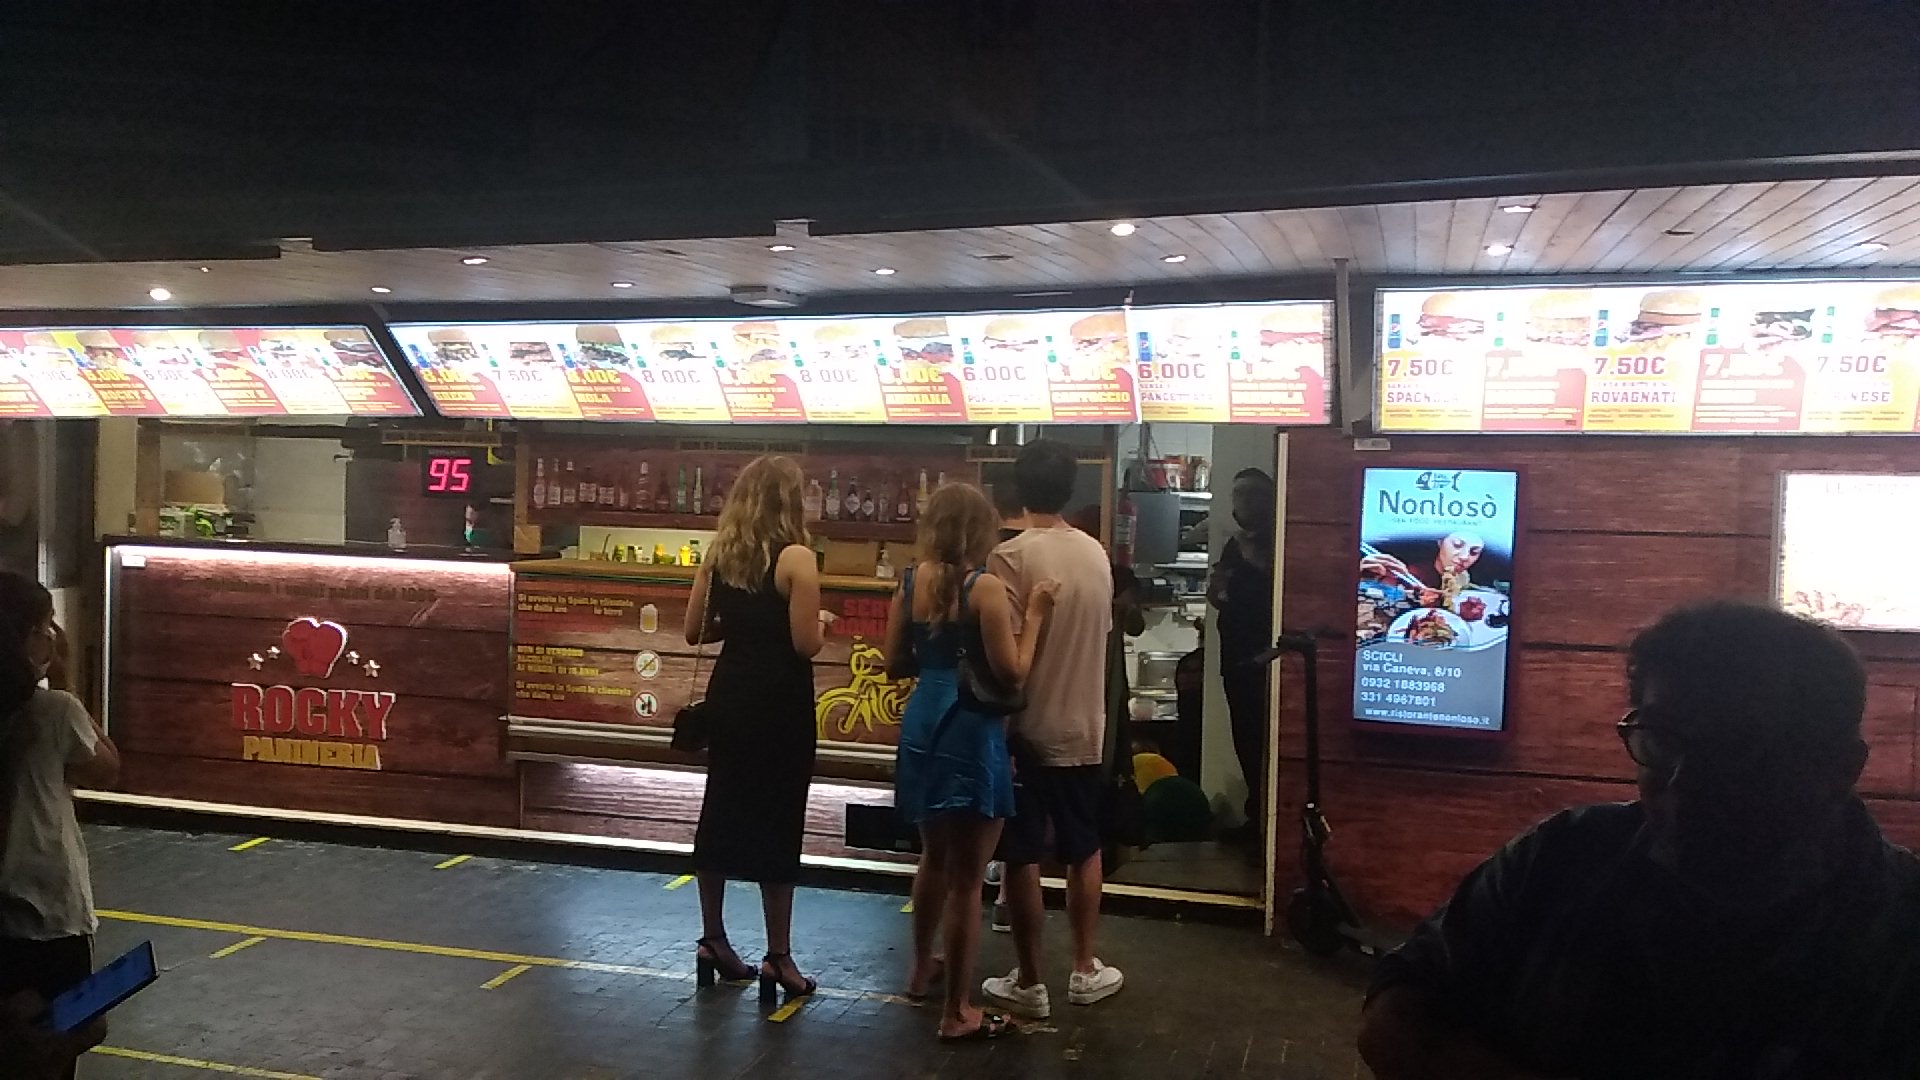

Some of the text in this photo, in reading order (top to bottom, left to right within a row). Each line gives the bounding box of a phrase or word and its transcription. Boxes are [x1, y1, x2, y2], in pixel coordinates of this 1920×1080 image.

[1387, 391, 1459, 403] SPAGNOA
[1591, 391, 1677, 403] ROVAGNATI
[427, 458, 472, 491] 95
[1379, 490, 1497, 519] Nonlosò
[1362, 650, 1403, 663] SCICLI
[1363, 663, 1381, 672] via
[1361, 676, 1391, 690] 0932
[1361, 691, 1381, 702] 331
[231, 682, 396, 741] ROCKY
